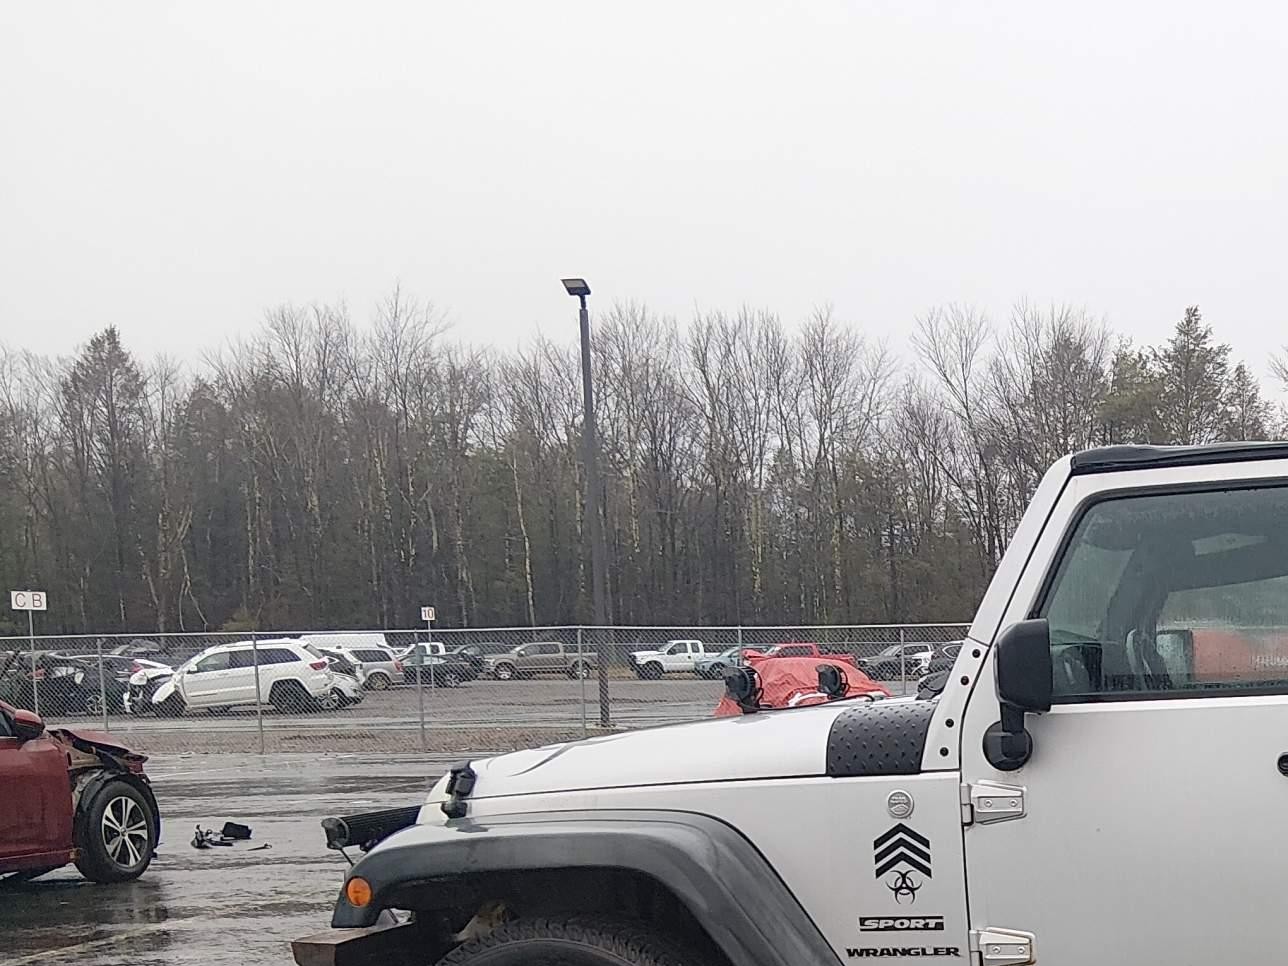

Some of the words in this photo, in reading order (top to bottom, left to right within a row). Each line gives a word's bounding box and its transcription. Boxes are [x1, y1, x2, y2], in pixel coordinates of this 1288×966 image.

[423, 608, 434, 619] 10
[859, 918, 943, 930] SPORT
[846, 947, 962, 957] WRANGLER
